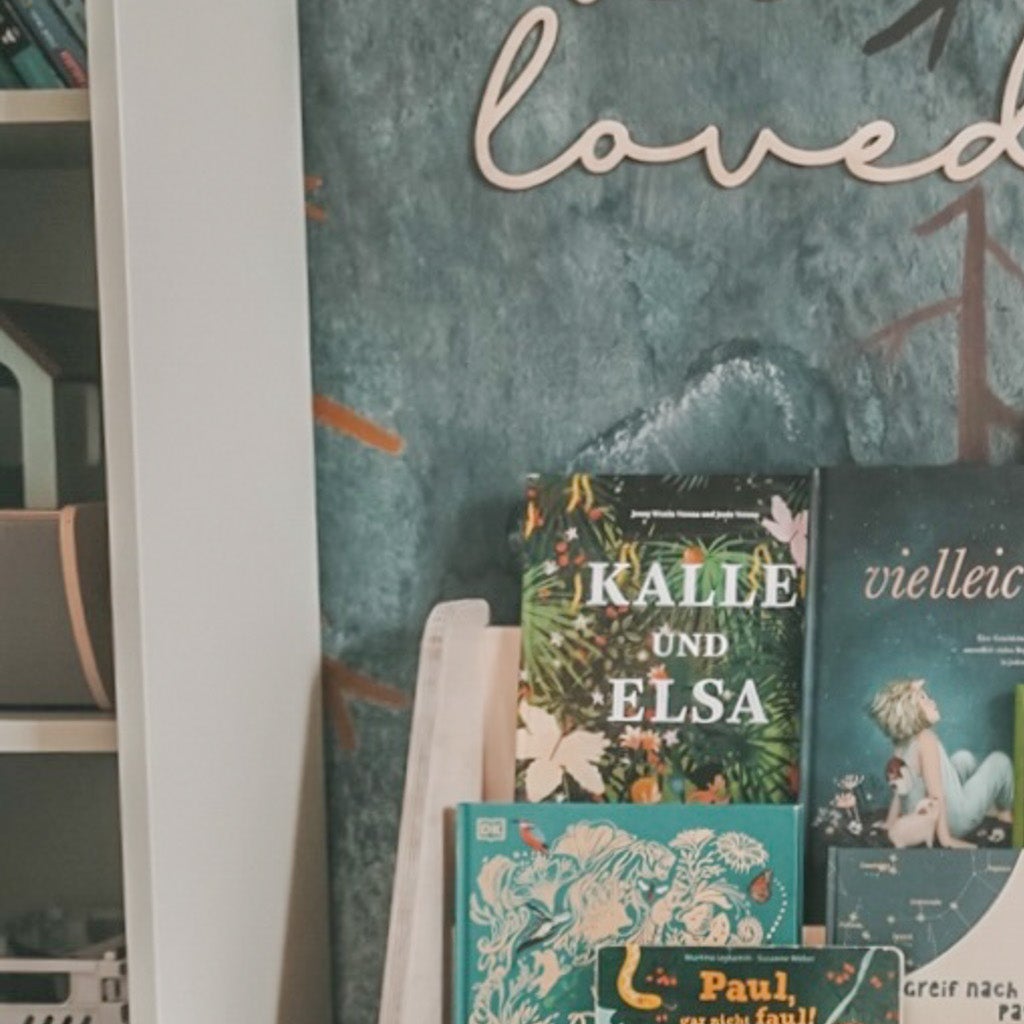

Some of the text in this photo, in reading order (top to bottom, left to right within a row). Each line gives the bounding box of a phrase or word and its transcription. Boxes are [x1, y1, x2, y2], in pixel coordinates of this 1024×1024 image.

[586, 561, 797, 608] KALLE
[651, 632, 729, 657] UND
[607, 677, 769, 724] ELSA
[699, 969, 796, 1008] Paul,
[966, 980, 1018, 999] nach
